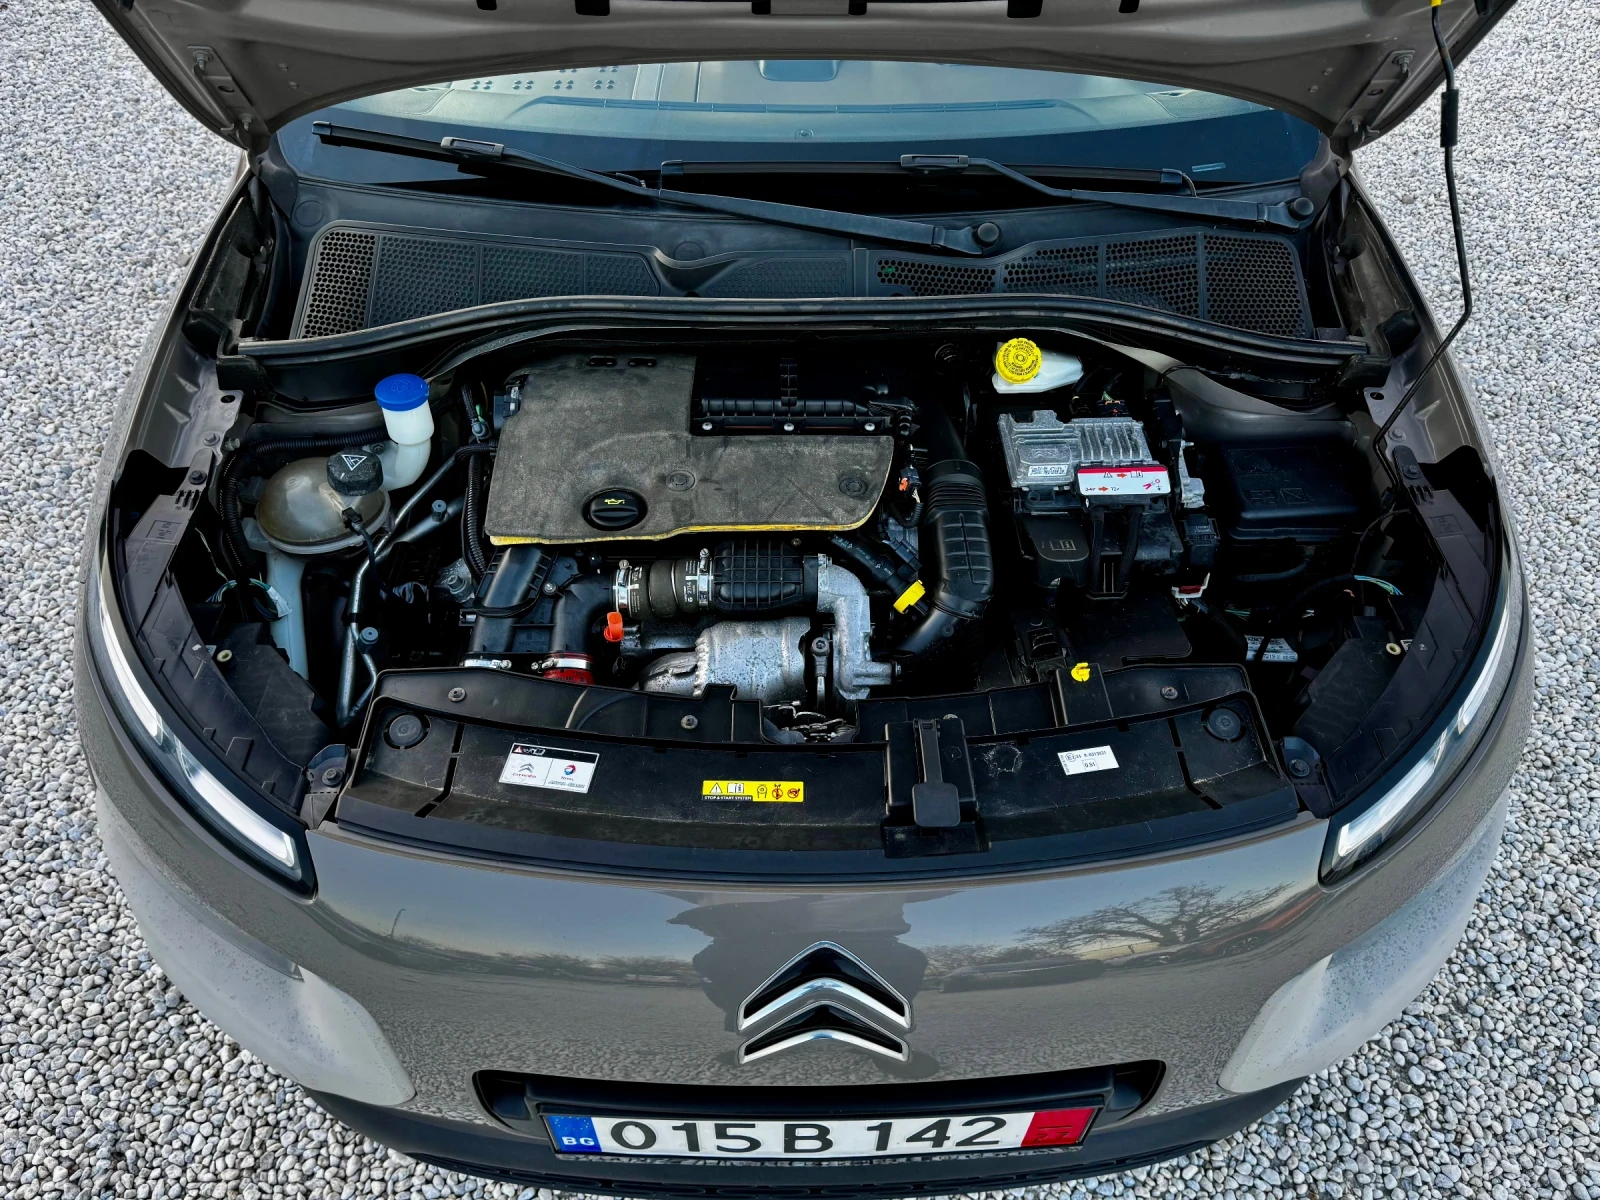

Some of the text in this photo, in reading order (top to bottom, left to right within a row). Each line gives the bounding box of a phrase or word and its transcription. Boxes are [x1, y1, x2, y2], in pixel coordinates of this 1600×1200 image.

[561, 1136, 595, 1146] BG
[783, 1123, 834, 1154] B
[866, 1116, 1007, 1151] 142
